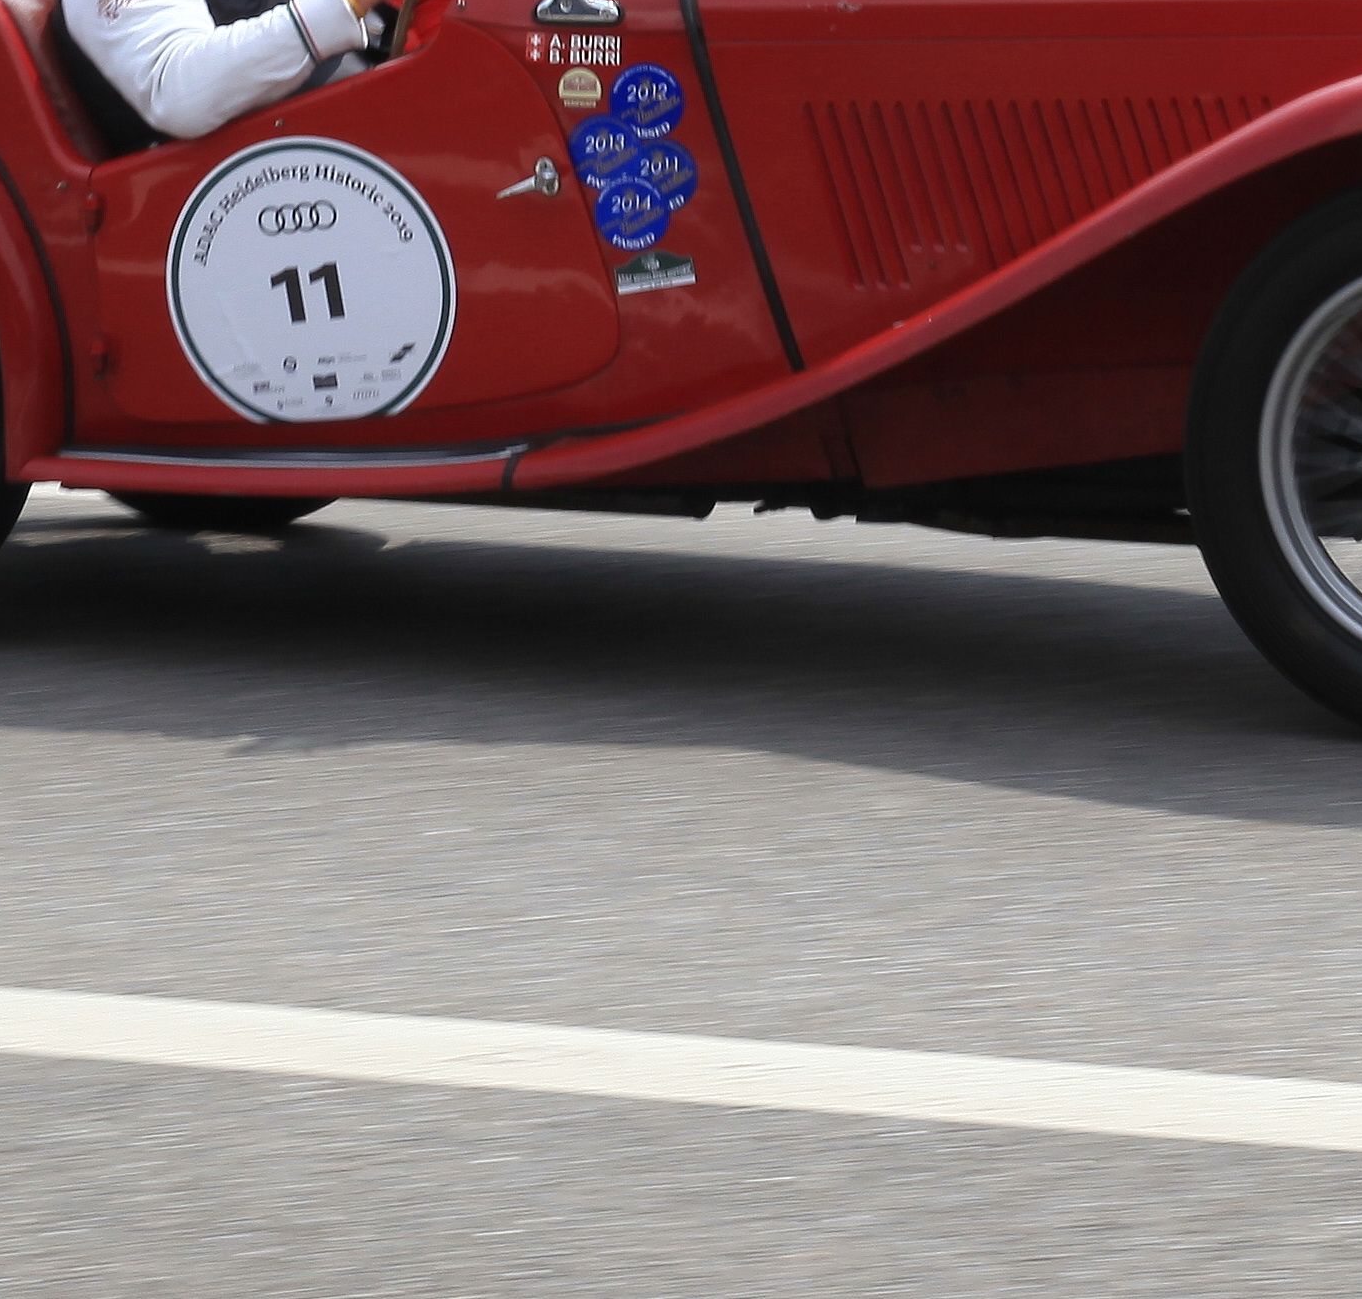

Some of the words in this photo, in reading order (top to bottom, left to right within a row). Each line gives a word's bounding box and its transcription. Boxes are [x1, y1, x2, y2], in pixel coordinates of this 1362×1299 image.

[550, 33, 565, 50] A.
[570, 34, 621, 51] BURRI
[570, 49, 621, 66] BURRI
[627, 82, 668, 103] 2012
[585, 133, 625, 154] 2013
[640, 155, 679, 177] 2011
[219, 164, 310, 215] Heidelberg
[315, 163, 383, 206] Historic
[383, 203, 414, 243] 2019
[269, 260, 346, 324] 11
